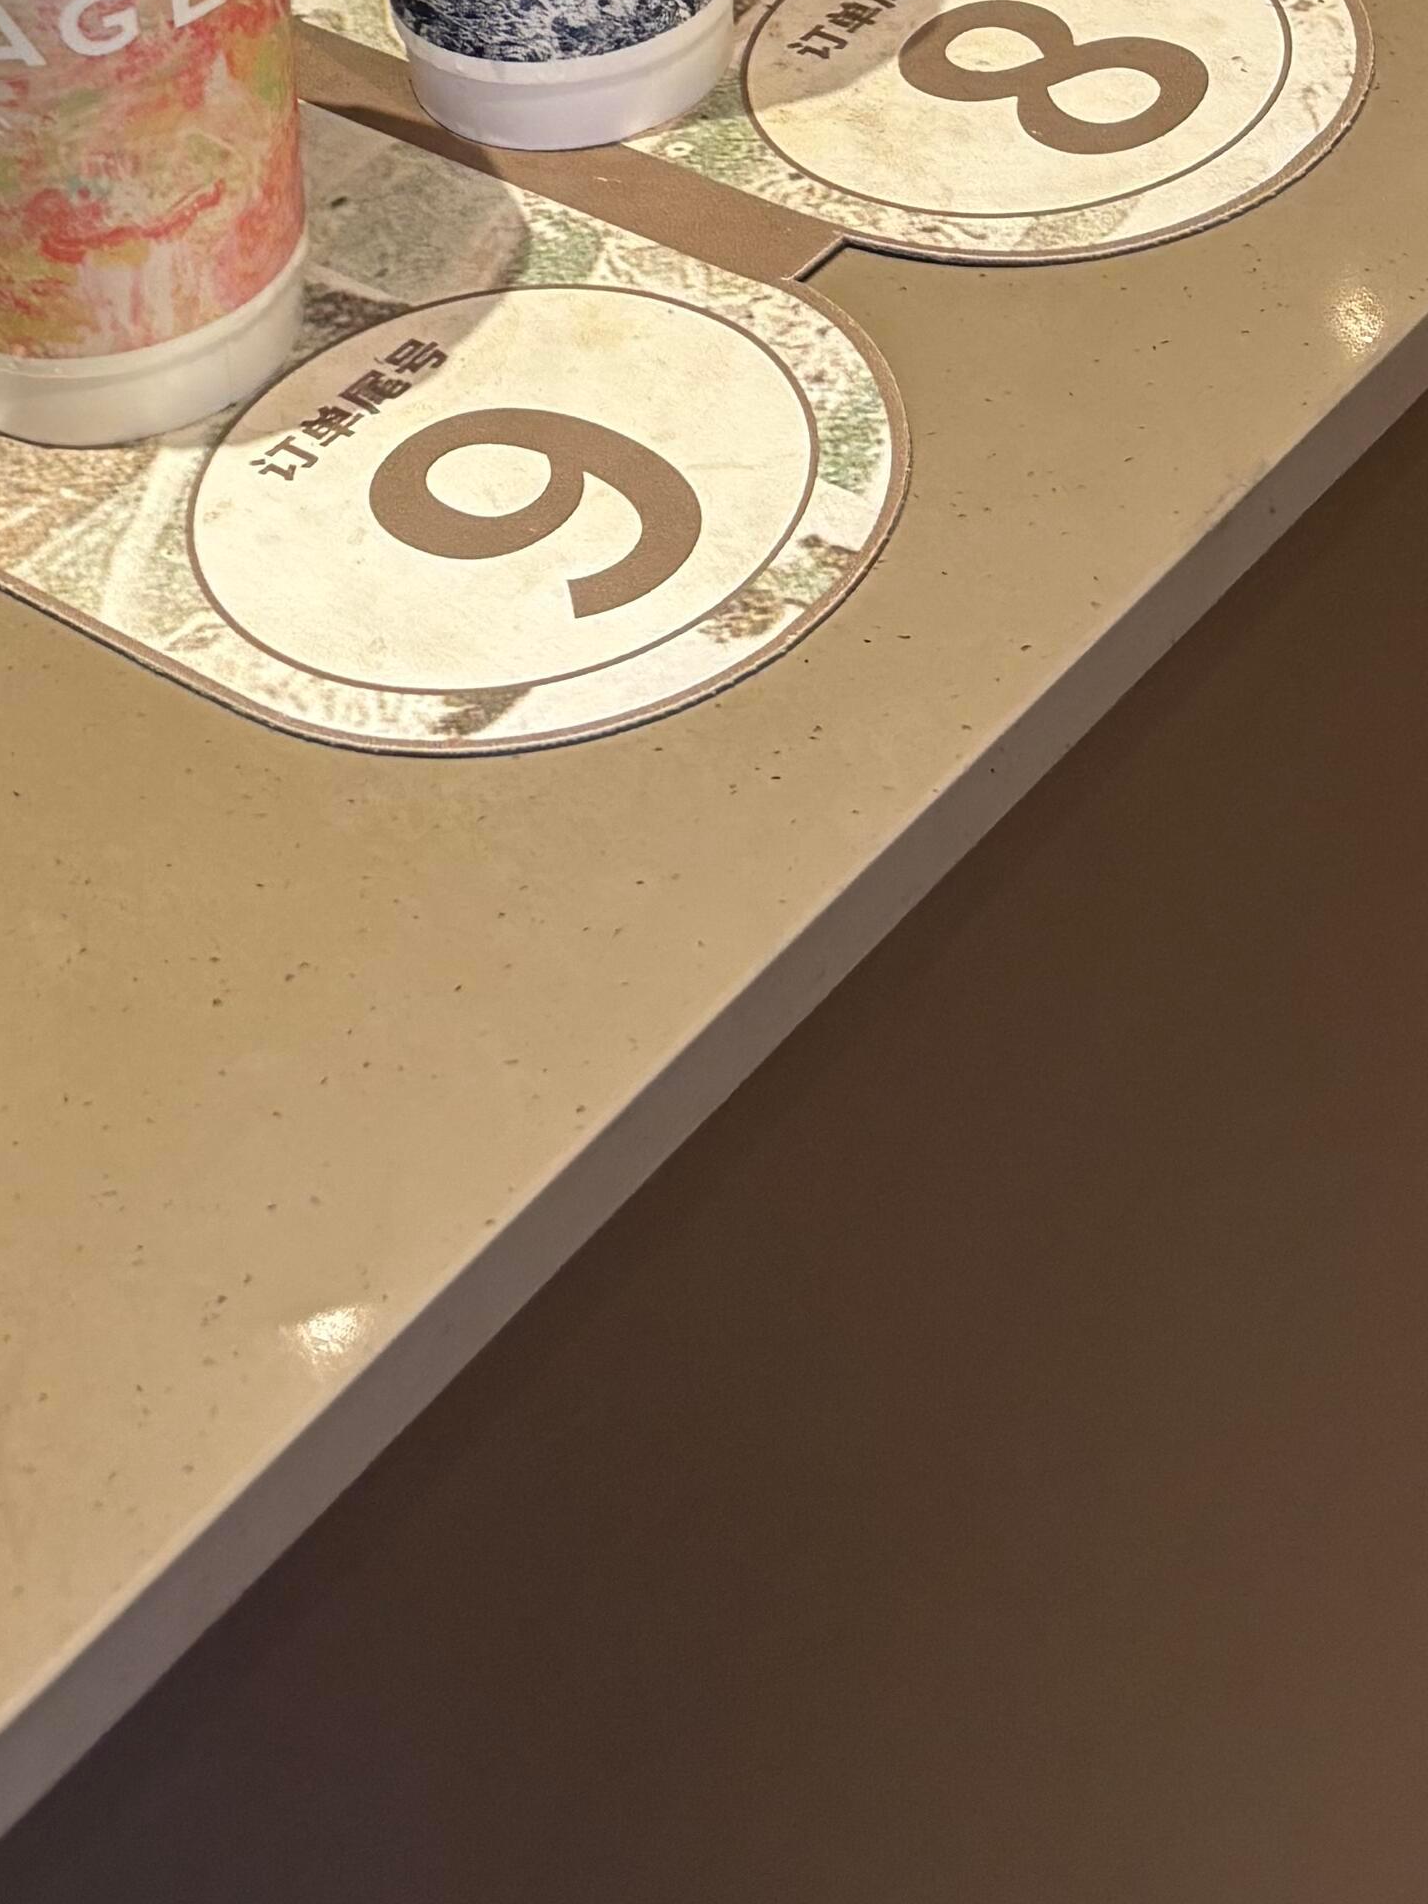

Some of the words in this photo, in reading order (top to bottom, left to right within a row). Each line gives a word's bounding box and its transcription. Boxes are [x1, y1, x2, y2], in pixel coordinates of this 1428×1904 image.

[249, 336, 449, 484] 订单尾号
[368, 406, 703, 620] 9
